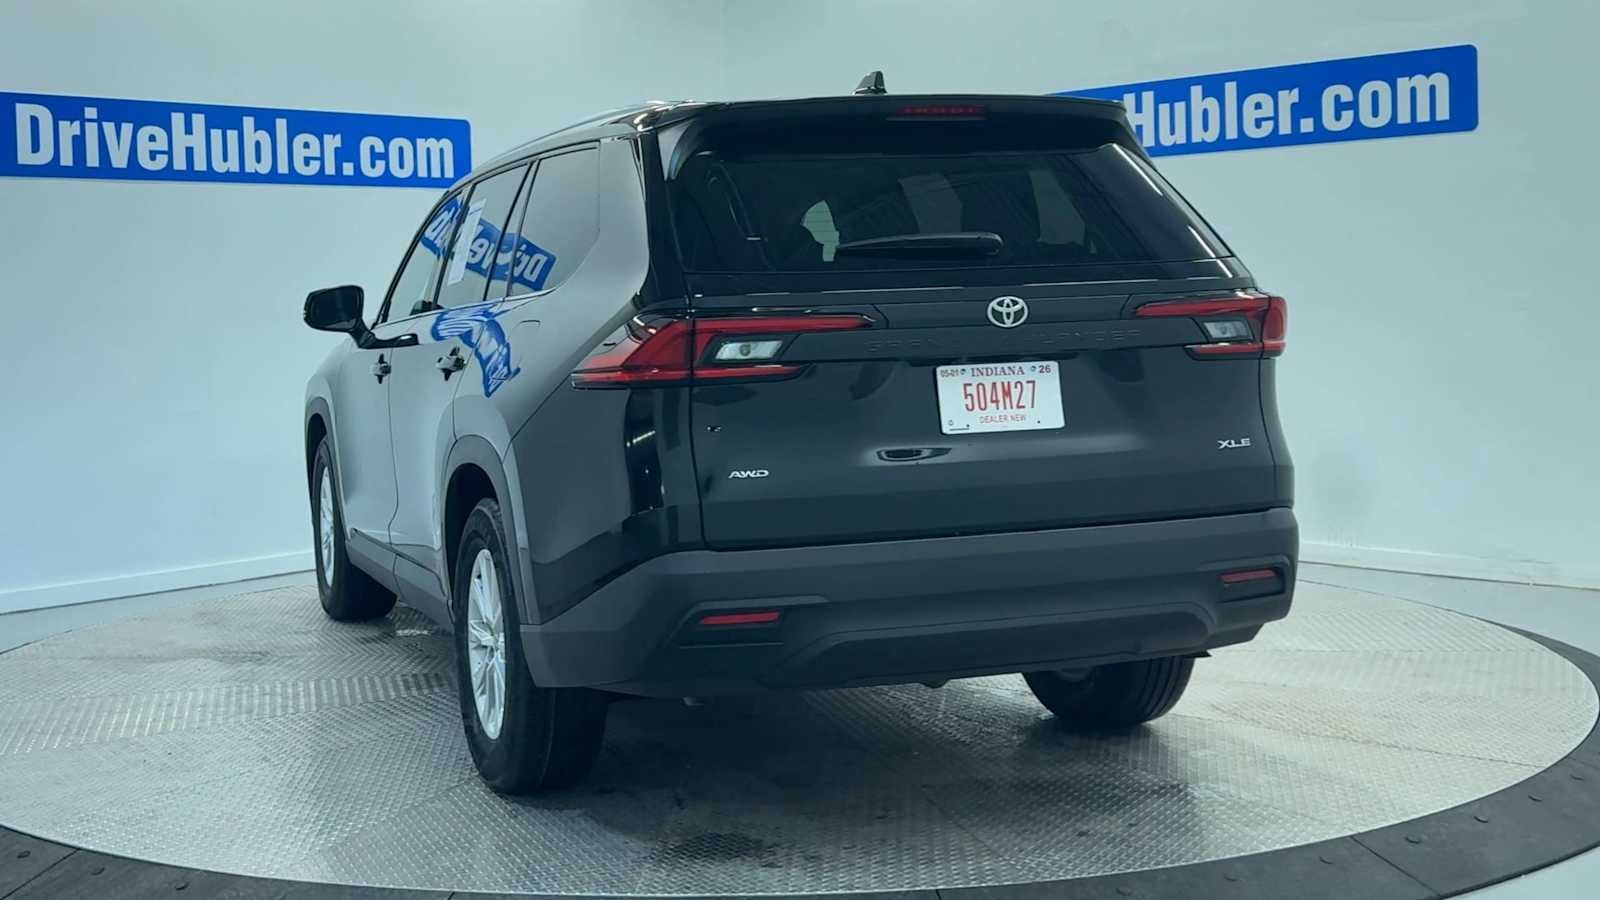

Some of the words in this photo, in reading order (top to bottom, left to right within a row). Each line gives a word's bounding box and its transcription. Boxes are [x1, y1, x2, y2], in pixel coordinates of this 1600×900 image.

[15, 102, 455, 179] DriveHubler.com
[971, 366, 1025, 377] INDIANA
[1038, 365, 1051, 374] 26
[963, 379, 1036, 412] 504M27
[1217, 437, 1251, 449] XLE
[728, 469, 769, 479] AWD
